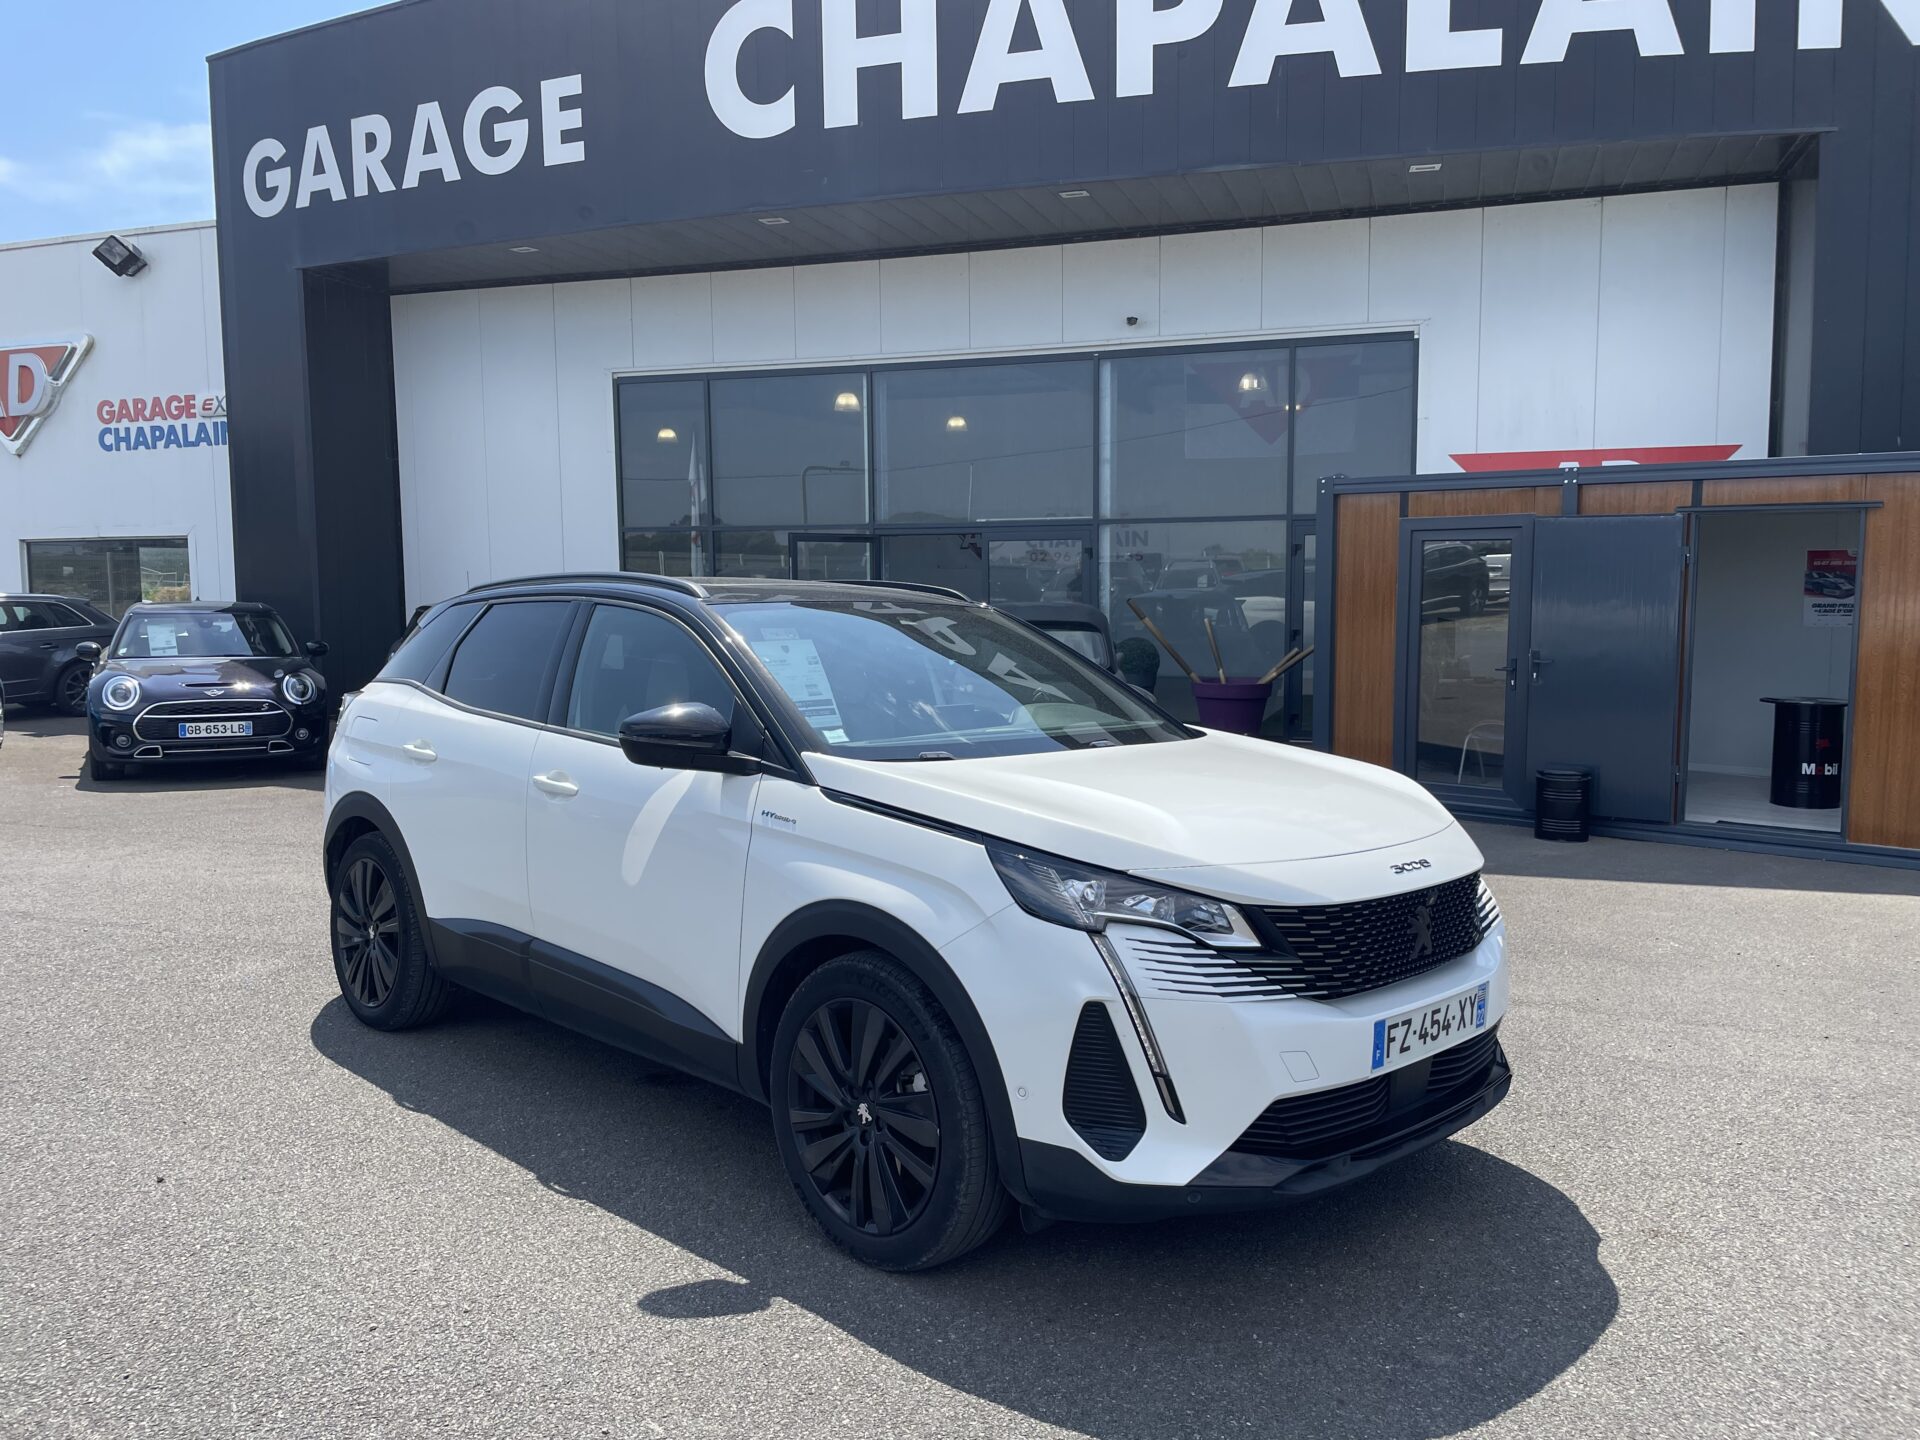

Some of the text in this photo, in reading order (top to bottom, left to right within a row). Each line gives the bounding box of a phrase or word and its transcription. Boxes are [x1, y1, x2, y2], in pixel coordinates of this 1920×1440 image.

[243, 0, 1920, 218] GARAGE CHAPA
[0, 353, 48, 417] D
[97, 395, 196, 424] GARAGE
[1801, 762, 1839, 776] Mobil
